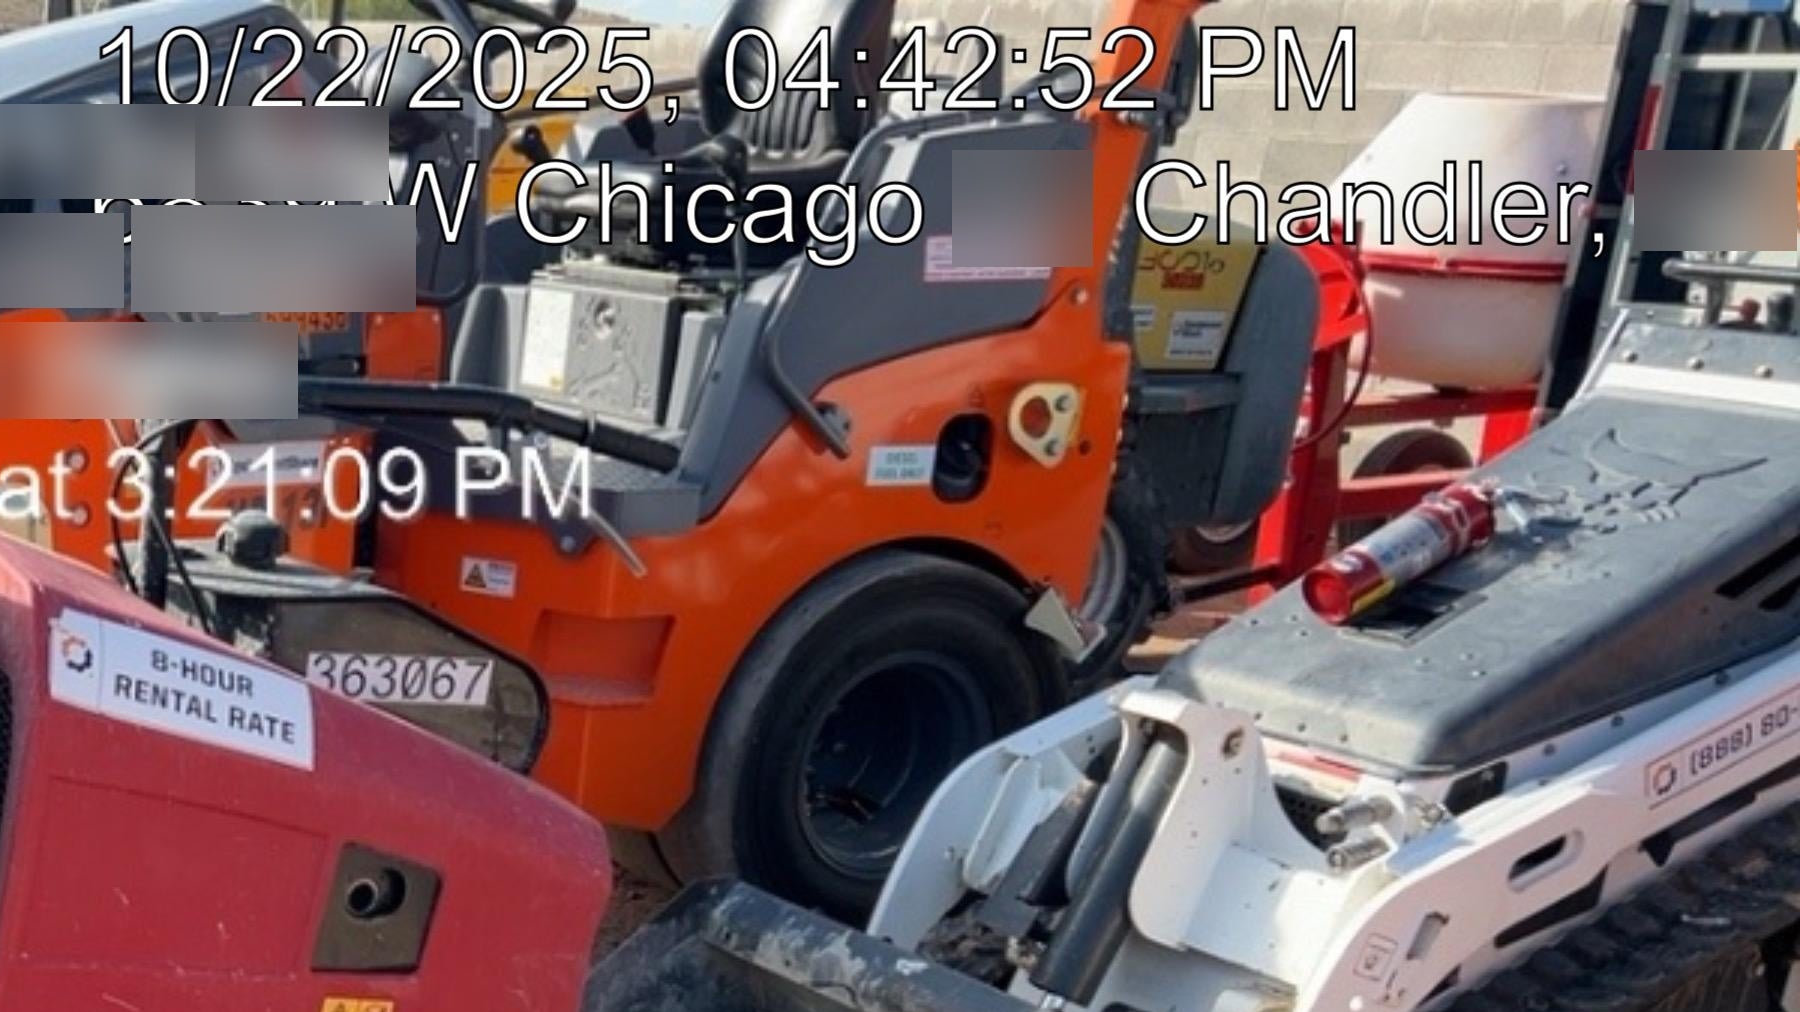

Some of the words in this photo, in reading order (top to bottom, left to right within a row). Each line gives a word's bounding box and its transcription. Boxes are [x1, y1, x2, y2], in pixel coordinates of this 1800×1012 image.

[151, 649, 254, 697] 8-HOUR
[313, 653, 490, 700] 363067
[113, 674, 217, 724] RENTAL
[227, 705, 296, 744] RATE
[1689, 721, 1753, 775] (888)
